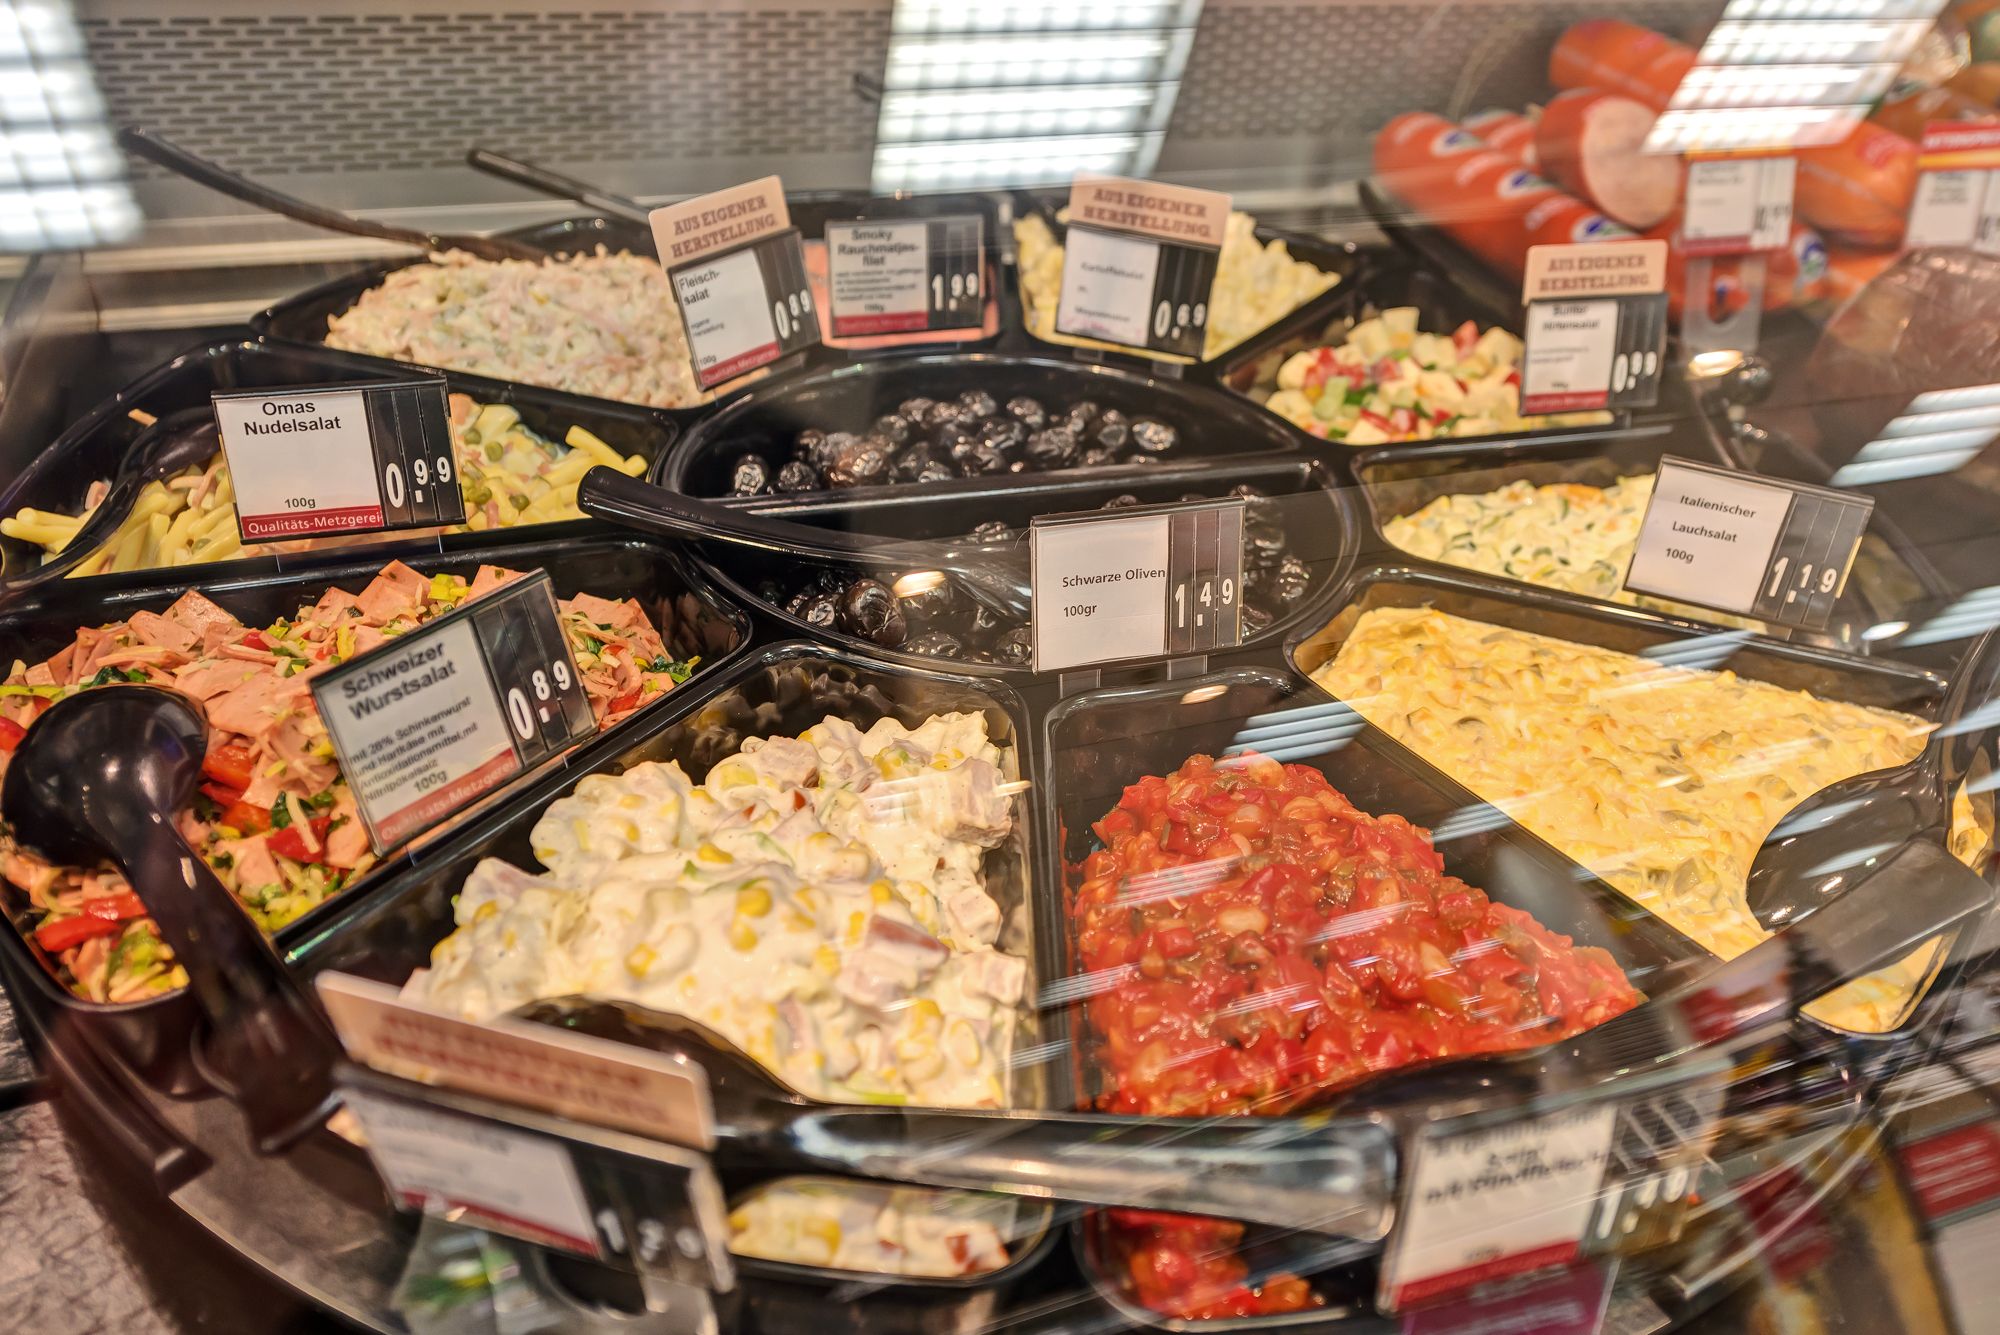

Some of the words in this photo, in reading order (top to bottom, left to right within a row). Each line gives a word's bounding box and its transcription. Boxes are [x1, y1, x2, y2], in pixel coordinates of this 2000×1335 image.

[673, 215, 700, 236] AUS
[701, 195, 767, 227] EIGENER
[1126, 193, 1208, 218] EIGENER
[1083, 205, 1211, 238] HERSTELLUNG
[670, 213, 777, 258] HERSTELLUNG
[683, 288, 710, 306] salat
[262, 401, 316, 416] Omas
[244, 416, 342, 436] Nudelsalat
[284, 497, 316, 509] 100g
[1679, 494, 1757, 519] Italienischer
[1671, 520, 1738, 543] Lauchsalat
[1665, 547, 1695, 565] 100g
[1062, 572, 1121, 588] Schwarze
[1125, 567, 1166, 581] Oliven
[1768, 556, 1838, 604] 1.19
[1063, 603, 1098, 618] 100gr
[1174, 578, 1234, 628] 1.49
[341, 642, 444, 700] Schweizer
[348, 660, 456, 721] Wurstsalat
[394, 696, 472, 741] Schinkenwurst
[427, 724, 447, 741] mit
[413, 770, 448, 794] 100g
